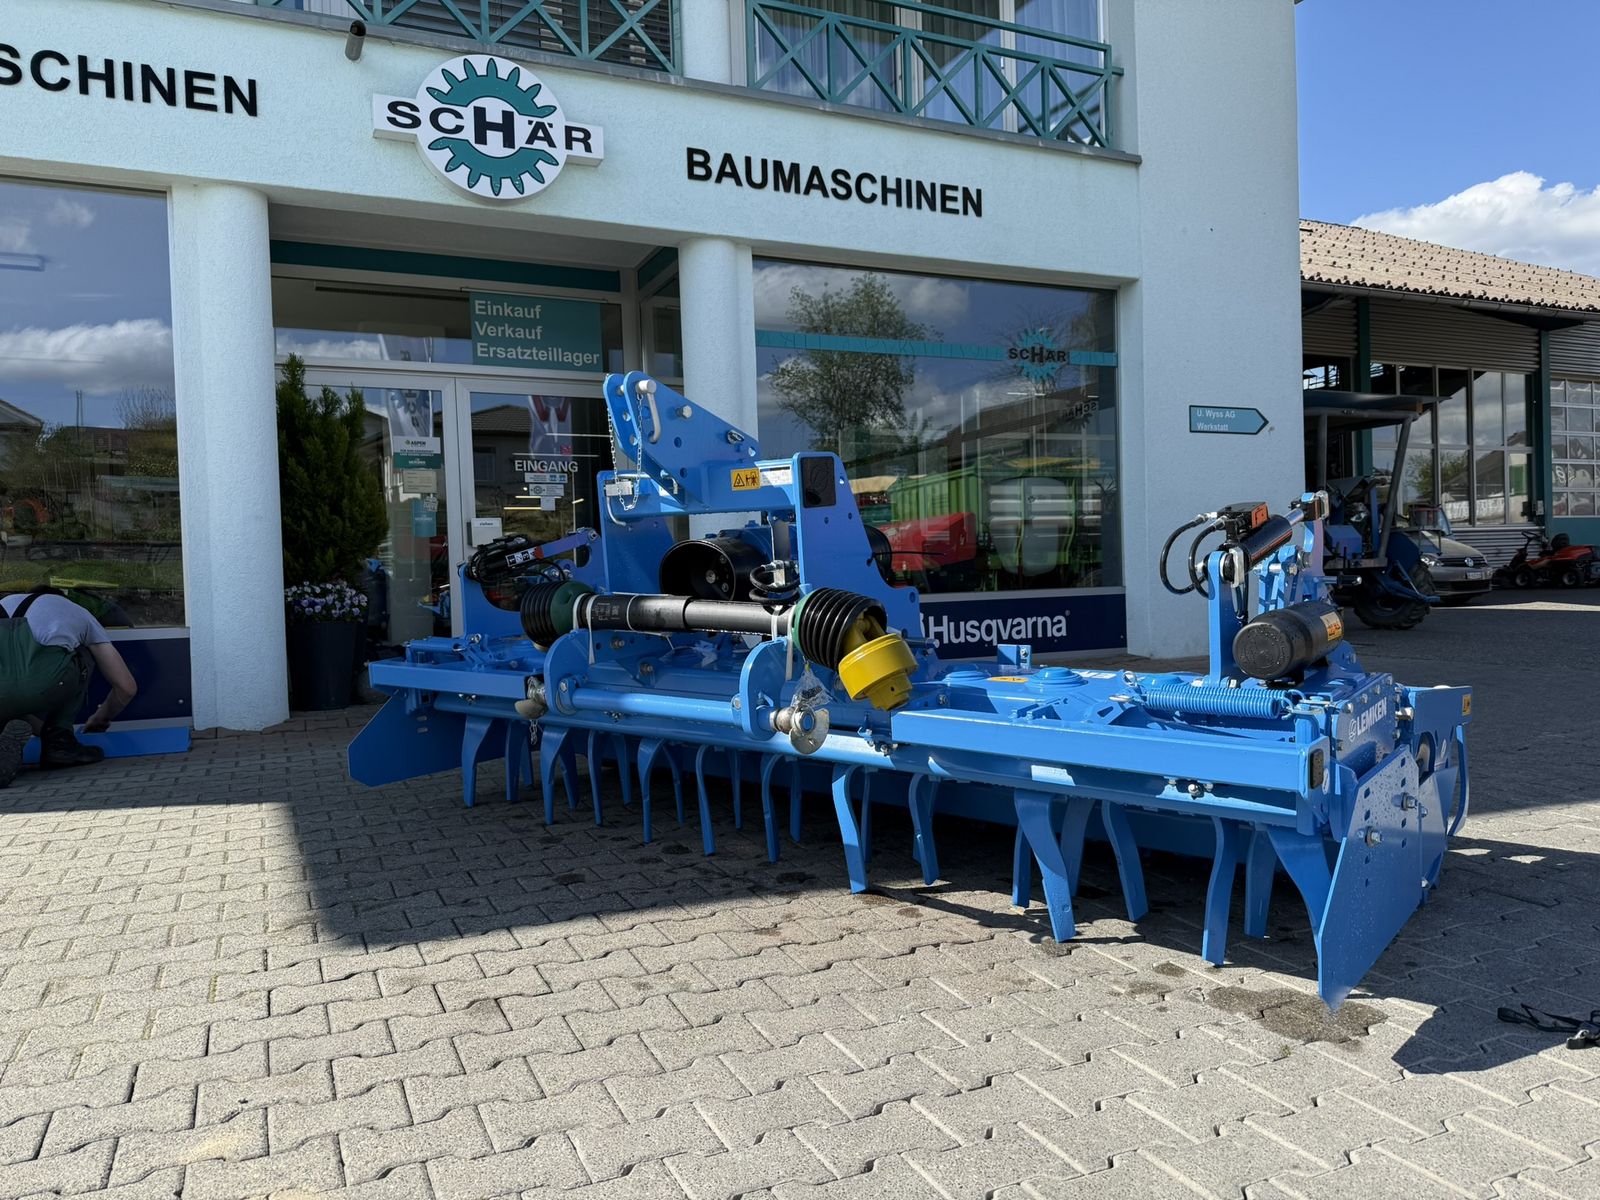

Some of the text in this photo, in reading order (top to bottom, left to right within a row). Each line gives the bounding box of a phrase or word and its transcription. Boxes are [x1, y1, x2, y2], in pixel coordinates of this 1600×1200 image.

[0, 42, 257, 117] SCHINEN
[386, 100, 593, 153] SCHÄR
[686, 147, 983, 217] BAUMASCHINEN
[475, 299, 542, 319] Einkauf
[475, 321, 543, 340] Verkauf
[476, 342, 600, 366] Ersatzteillager
[1196, 409, 1236, 419] U. Wyss AG
[1196, 421, 1229, 431] Werkstatt
[514, 459, 579, 472] EINGANG
[928, 615, 1067, 646] Husqvarna
[1356, 696, 1387, 736] LEMKEN
